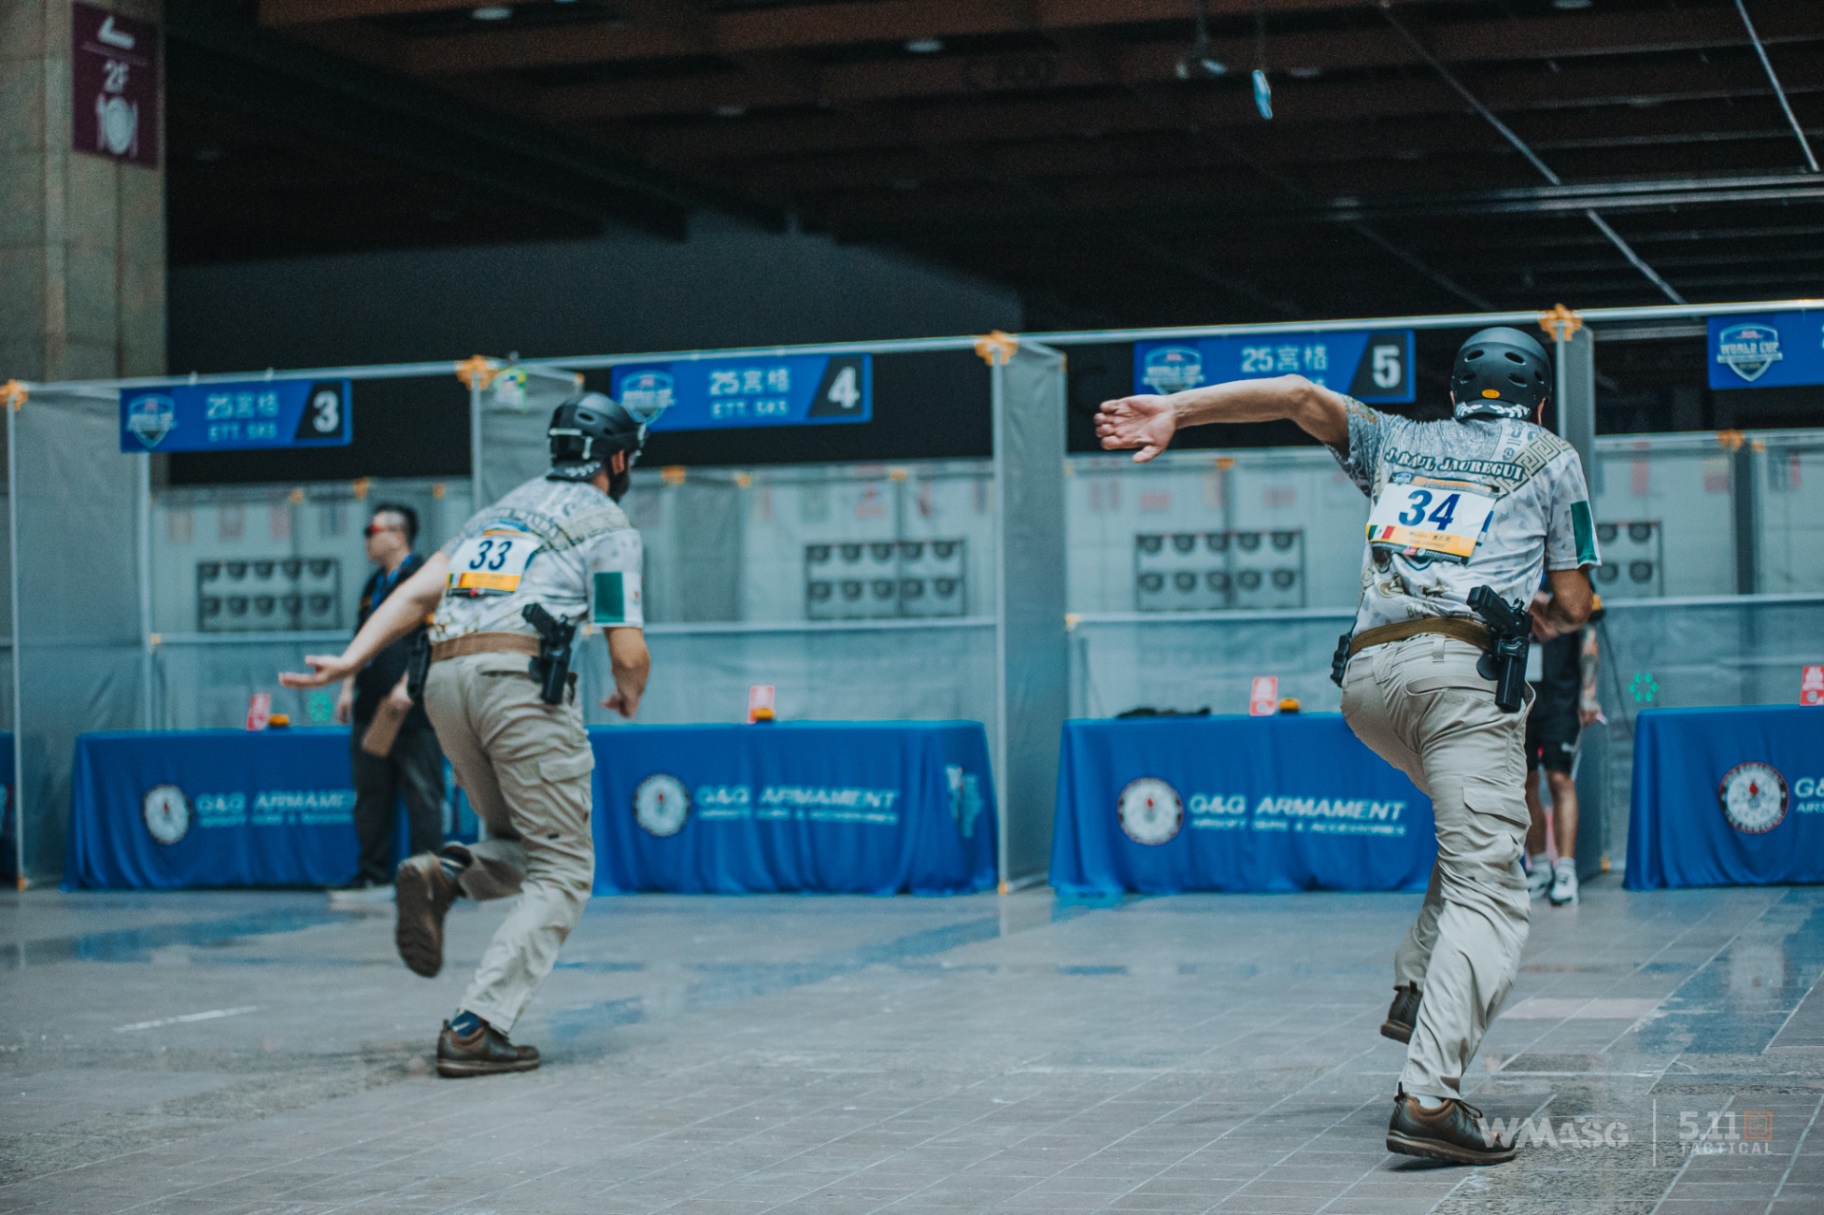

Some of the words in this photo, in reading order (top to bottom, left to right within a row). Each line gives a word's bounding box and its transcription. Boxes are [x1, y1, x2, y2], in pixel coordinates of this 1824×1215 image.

[828, 366, 860, 409] 4
[1372, 344, 1401, 389] 5
[312, 390, 339, 433] 3
[1438, 458, 1525, 482] JAUREGUI
[1398, 489, 1461, 531] 34
[469, 540, 512, 570] 33
[1254, 796, 1407, 821] ARMAMENT
